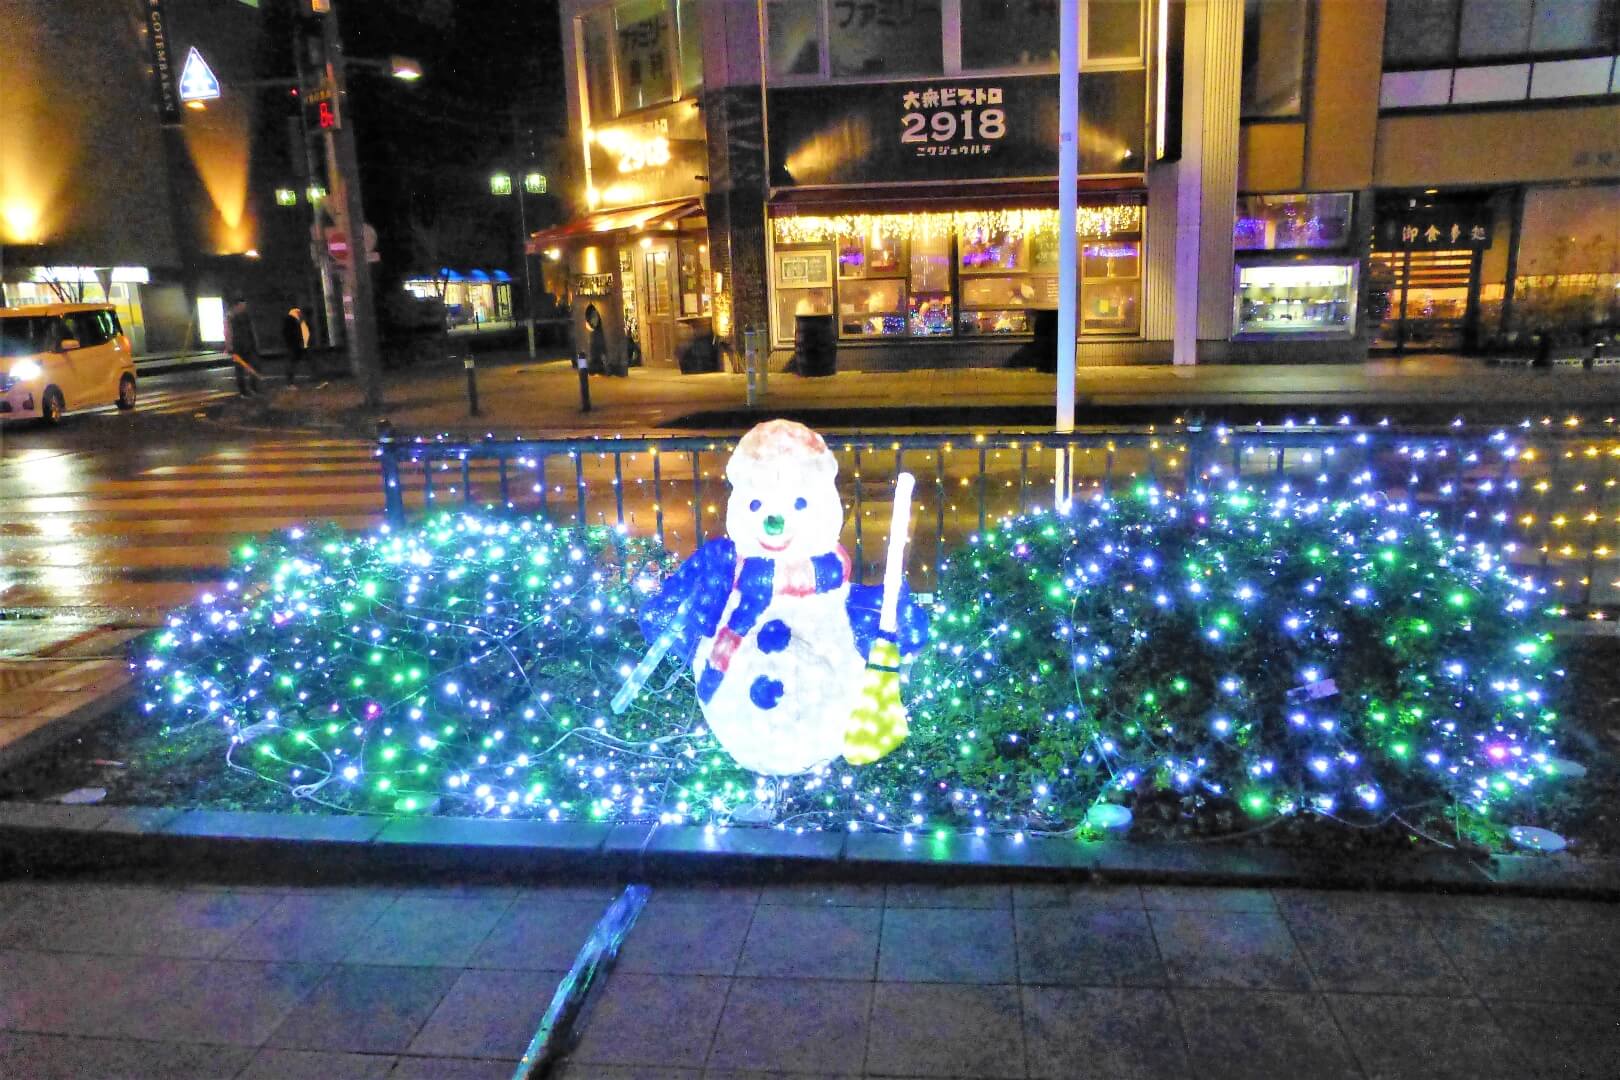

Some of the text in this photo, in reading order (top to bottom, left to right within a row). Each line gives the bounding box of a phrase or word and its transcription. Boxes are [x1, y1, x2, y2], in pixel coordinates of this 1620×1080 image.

[902, 87, 1004, 110] 大衆ビストロ
[900, 108, 1006, 144] 2918
